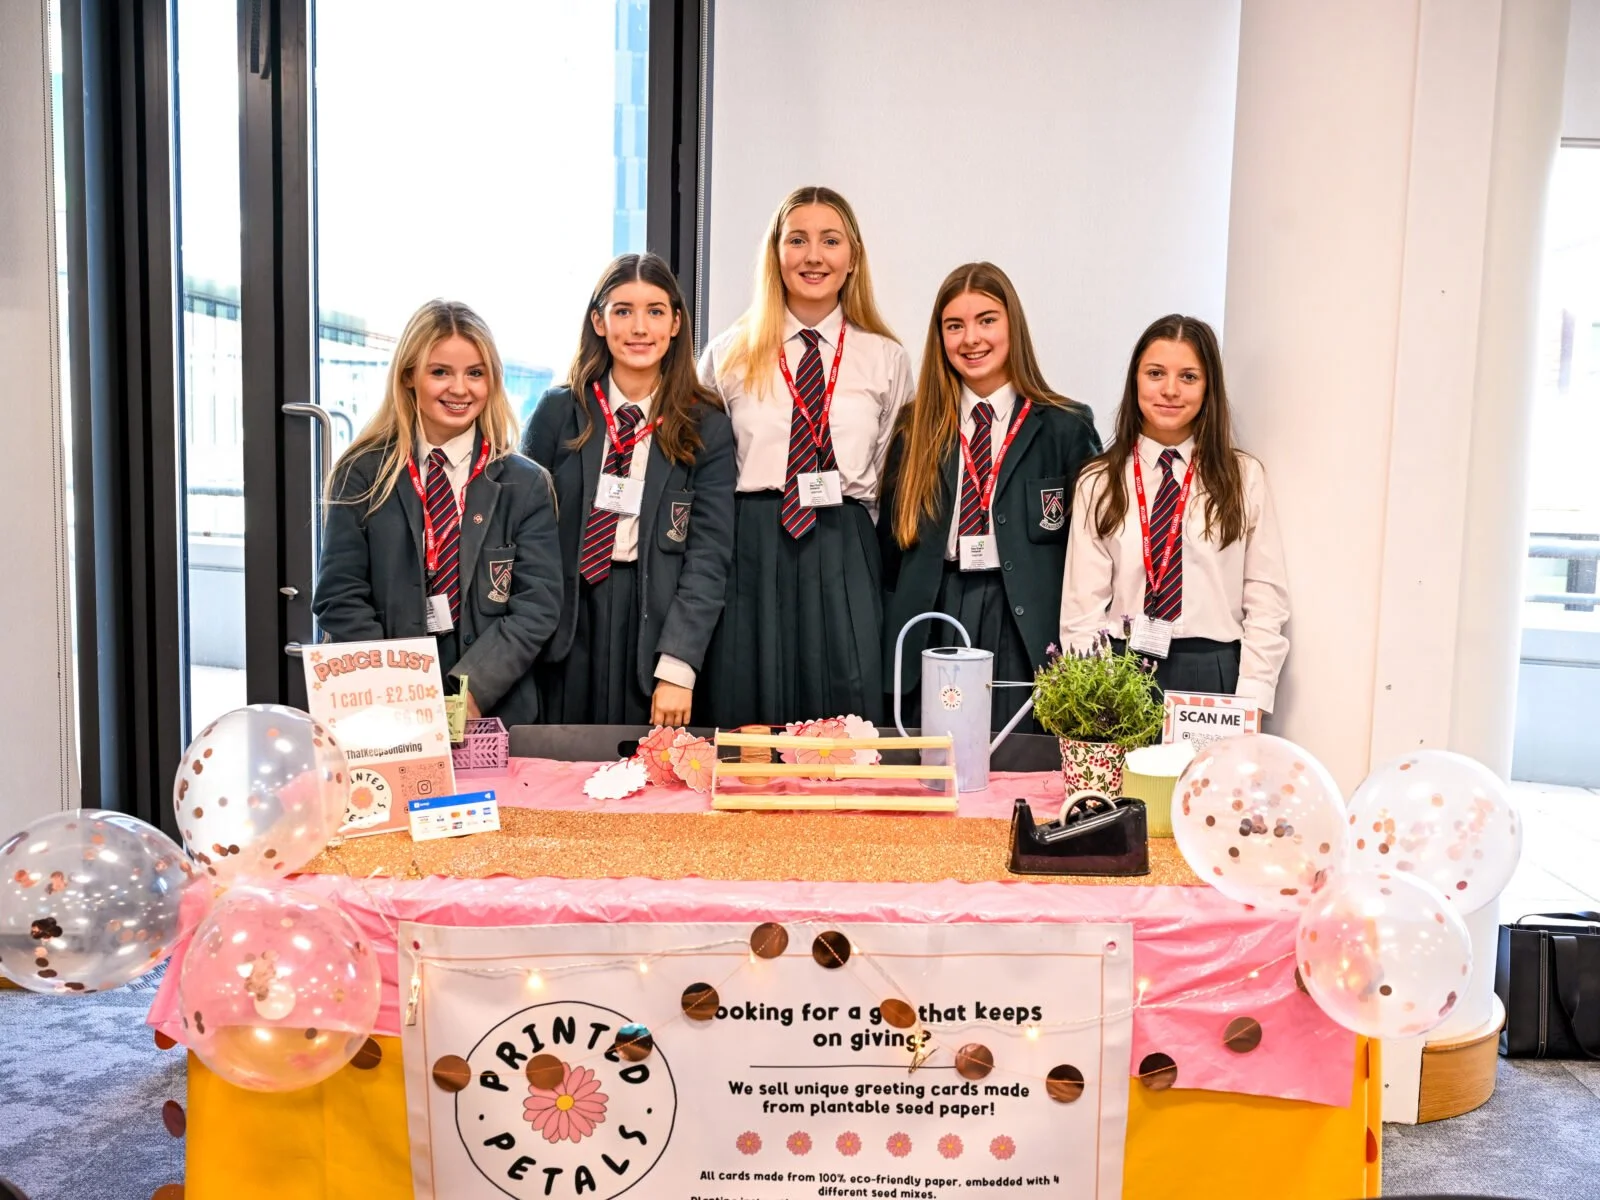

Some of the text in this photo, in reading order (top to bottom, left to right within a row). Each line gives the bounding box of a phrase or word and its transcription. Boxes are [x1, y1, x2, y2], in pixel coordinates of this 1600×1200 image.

[313, 650, 434, 682] PRICE LIST
[330, 692, 336, 709] 1
[341, 688, 373, 708] card
[386, 684, 424, 704] £2.50
[1179, 711, 1240, 726] SCAN ME
[714, 1001, 793, 1026] ooking
[802, 1003, 839, 1021] for
[848, 1006, 861, 1020] a
[919, 1003, 967, 1022] that
[976, 1002, 1042, 1023] keeps
[813, 1028, 932, 1052] on giving?
[728, 1081, 1030, 1099] We sell unique greeting cards made
[763, 1100, 995, 1118] from plantable seed paper!
[483, 1125, 648, 1196] PETALS
[700, 1171, 1060, 1188] All cards made from 100% eco-friendly paper, embedded with 4
[818, 1186, 937, 1199] different seed mixes.
